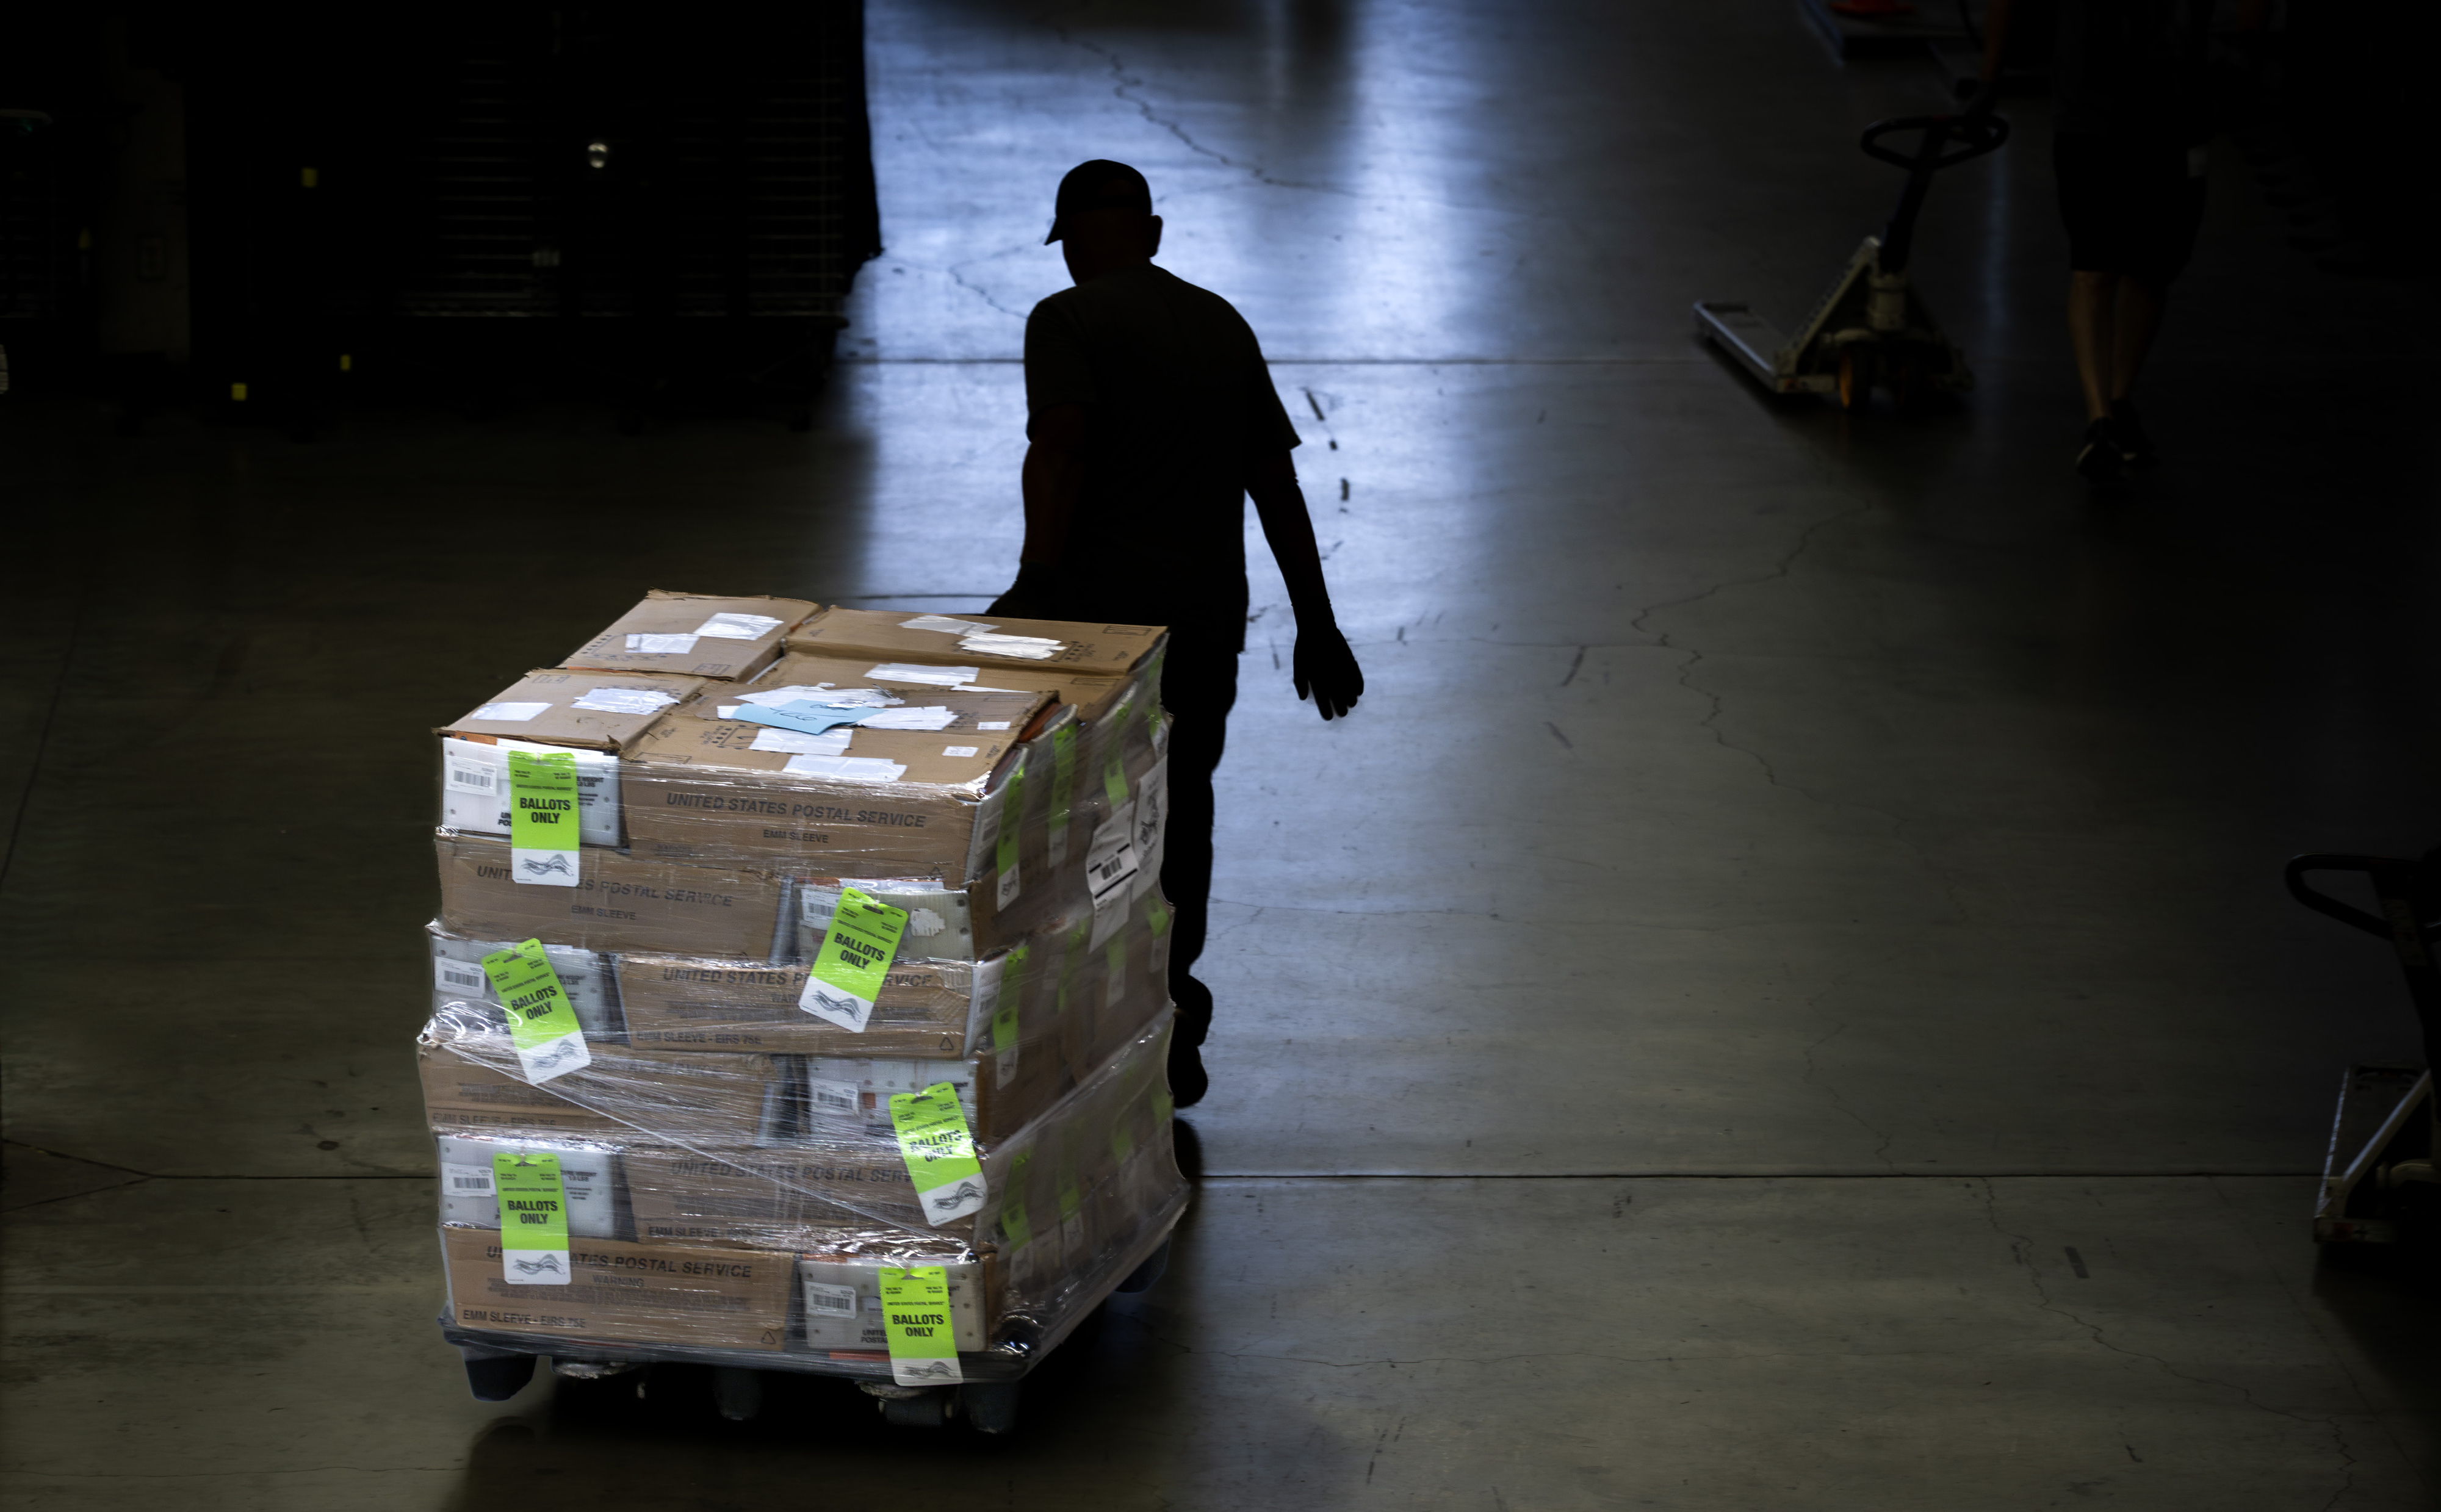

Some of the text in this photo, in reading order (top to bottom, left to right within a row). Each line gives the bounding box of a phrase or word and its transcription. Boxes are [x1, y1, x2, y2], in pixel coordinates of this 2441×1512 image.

[520, 797, 571, 811] BALLOTS
[667, 793, 926, 827] UNITED STATES POSTAL SERVICE
[531, 812, 560, 824] ONLY
[789, 832, 829, 843] SLEEVE
[477, 866, 512, 880] UNIT
[600, 881, 660, 898] POSTAL
[664, 889, 733, 907] SERVICE
[596, 908, 636, 920] SLEEVE
[834, 932, 885, 962] BALLOTS
[840, 949, 871, 970] ONLY
[663, 968, 721, 982] UNITED
[727, 971, 787, 985] STATES
[884, 974, 932, 987] RVICE
[510, 985, 558, 1010] BALLOTS
[525, 1002, 553, 1020] ONLY
[663, 1031, 706, 1043] SLEEVE
[909, 1130, 961, 1153] BALLOTS
[802, 1166, 864, 1181] POSTAL
[508, 1200, 558, 1212] BALLOTS
[521, 1214, 549, 1225] ONLY
[569, 1253, 752, 1278] ATES POSTAL SERVICE
[592, 1275, 644, 1287] WARNING
[463, 1309, 486, 1321] EMM
[490, 1311, 531, 1325] SLEEVE
[892, 1314, 944, 1325] BALLOTS
[906, 1327, 934, 1337] ONLY
